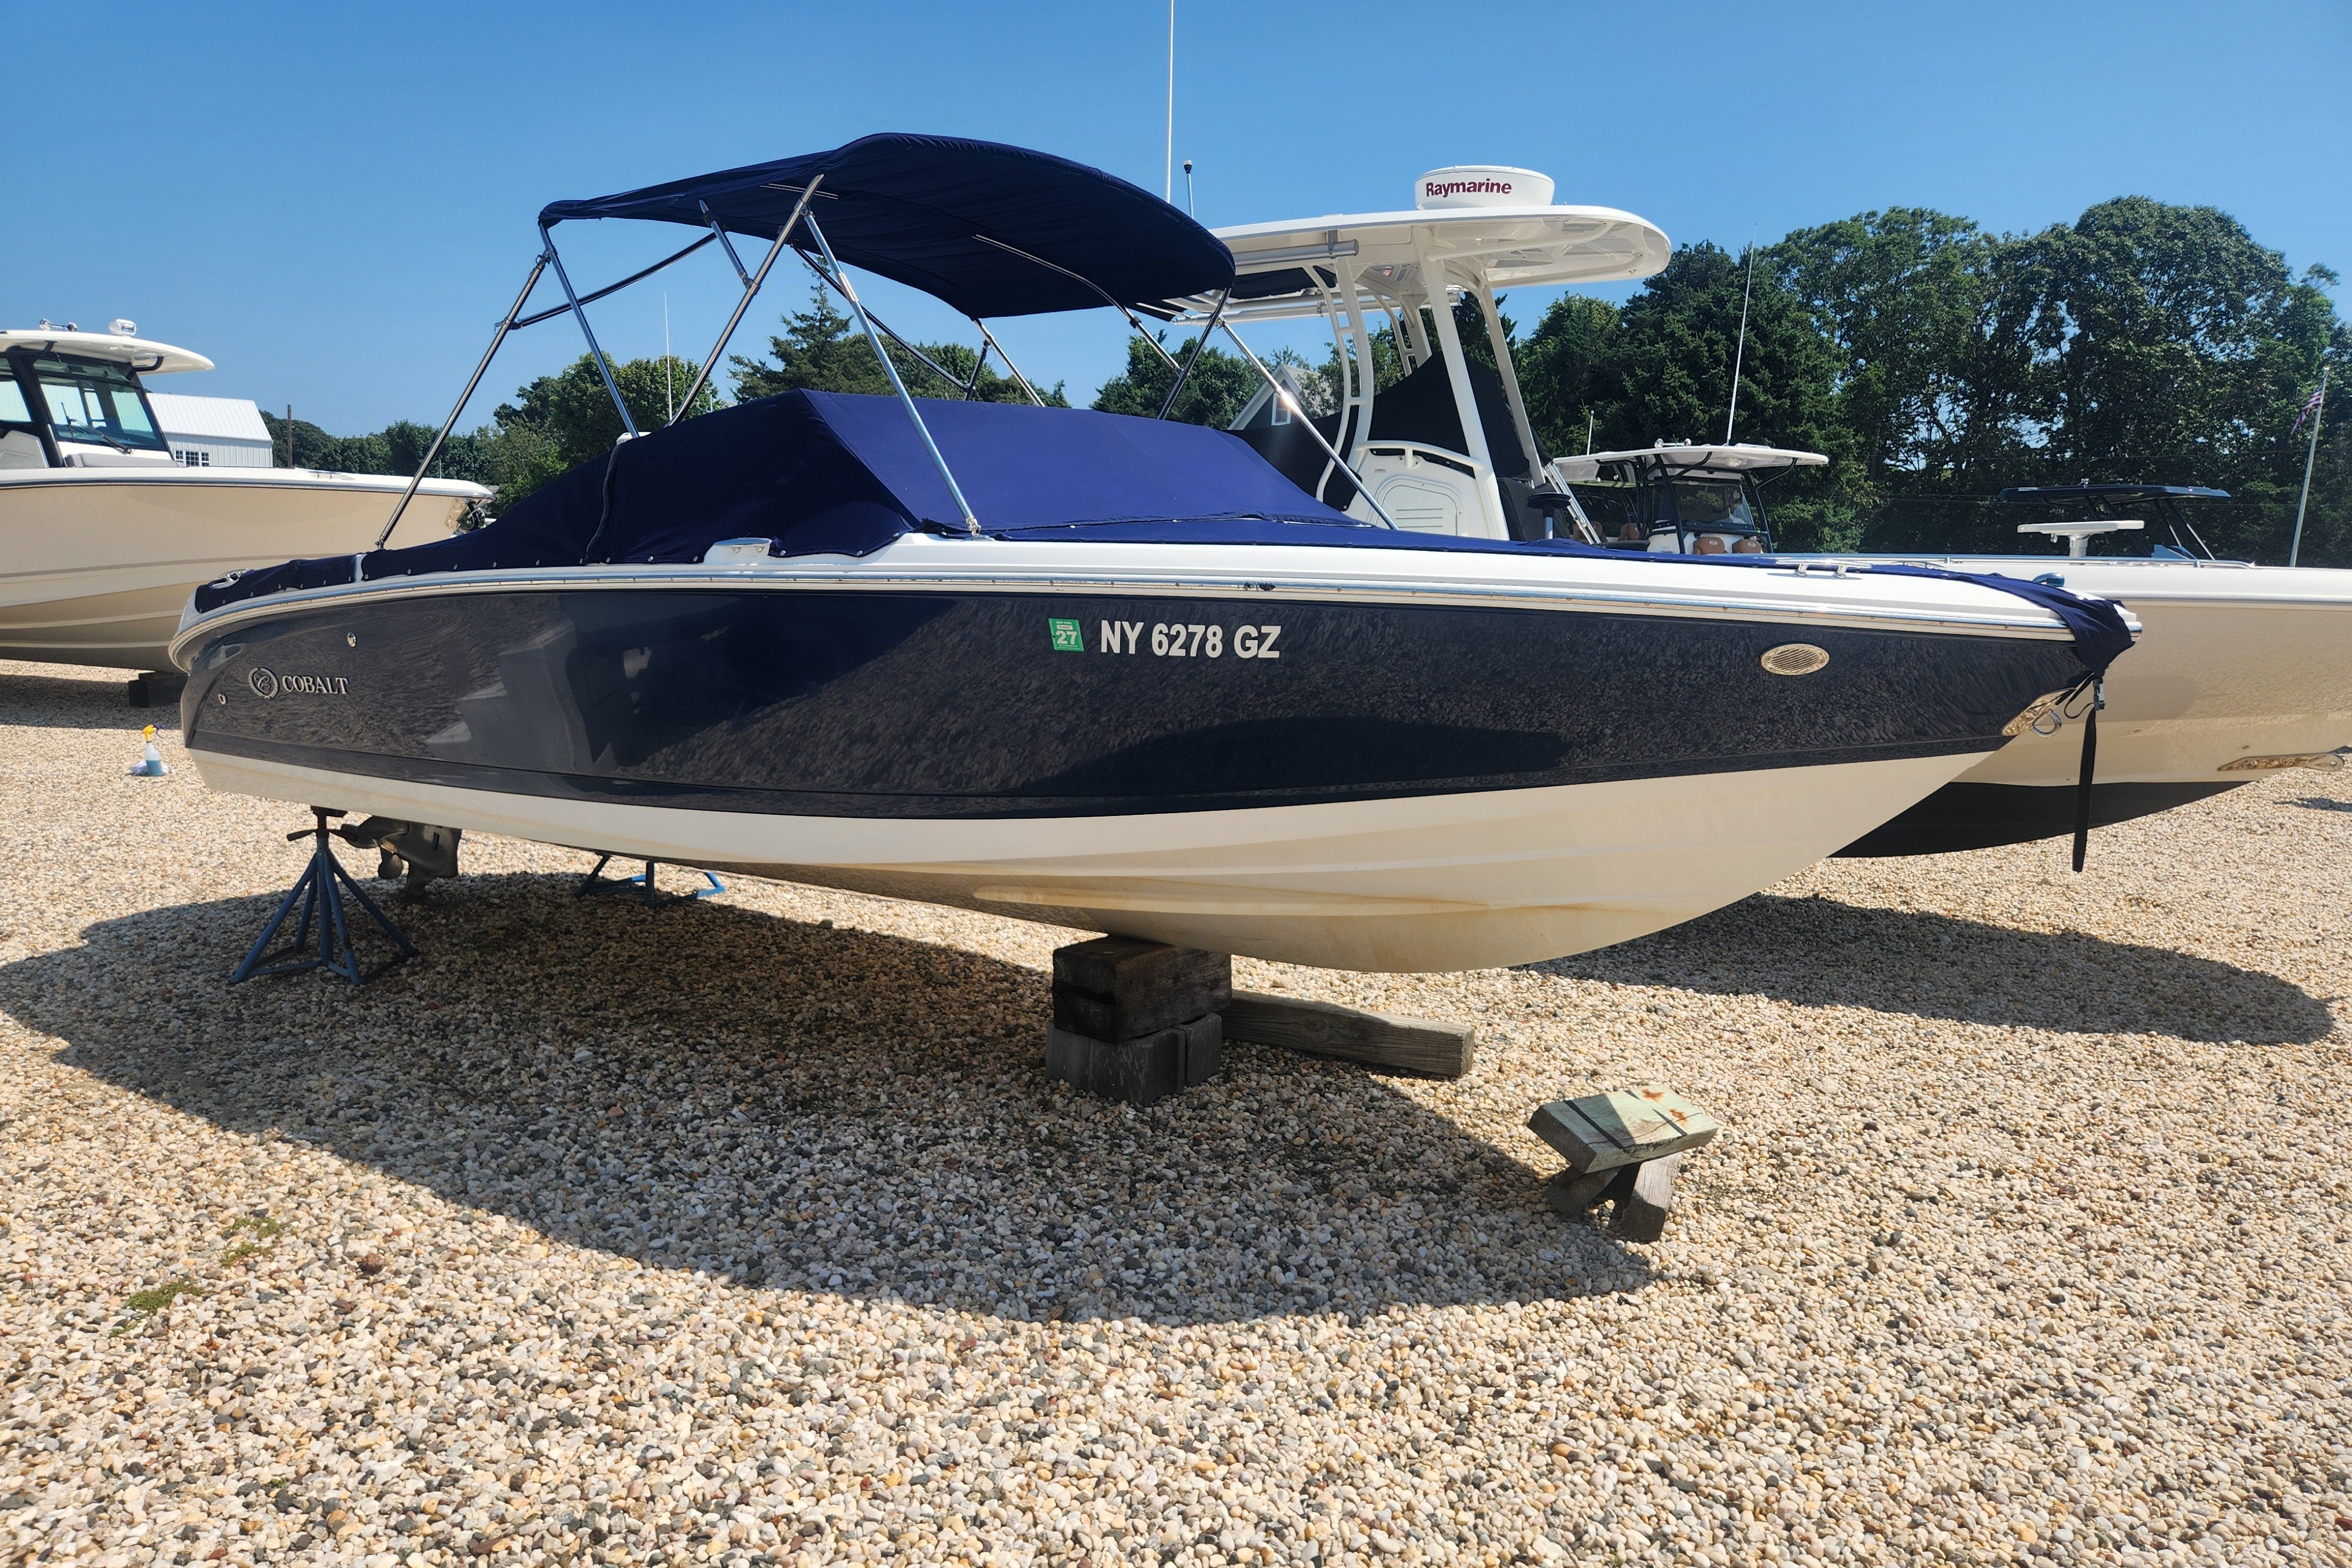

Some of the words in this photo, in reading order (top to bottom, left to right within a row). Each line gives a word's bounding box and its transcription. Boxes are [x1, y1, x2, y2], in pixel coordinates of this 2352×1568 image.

[1426, 178, 1512, 198] Raymarine
[1055, 630, 1077, 645] 27
[1101, 620, 1144, 654] NY
[1151, 623, 1223, 658] 6278
[1234, 625, 1281, 658] GZ
[282, 675, 349, 694] COBALT
